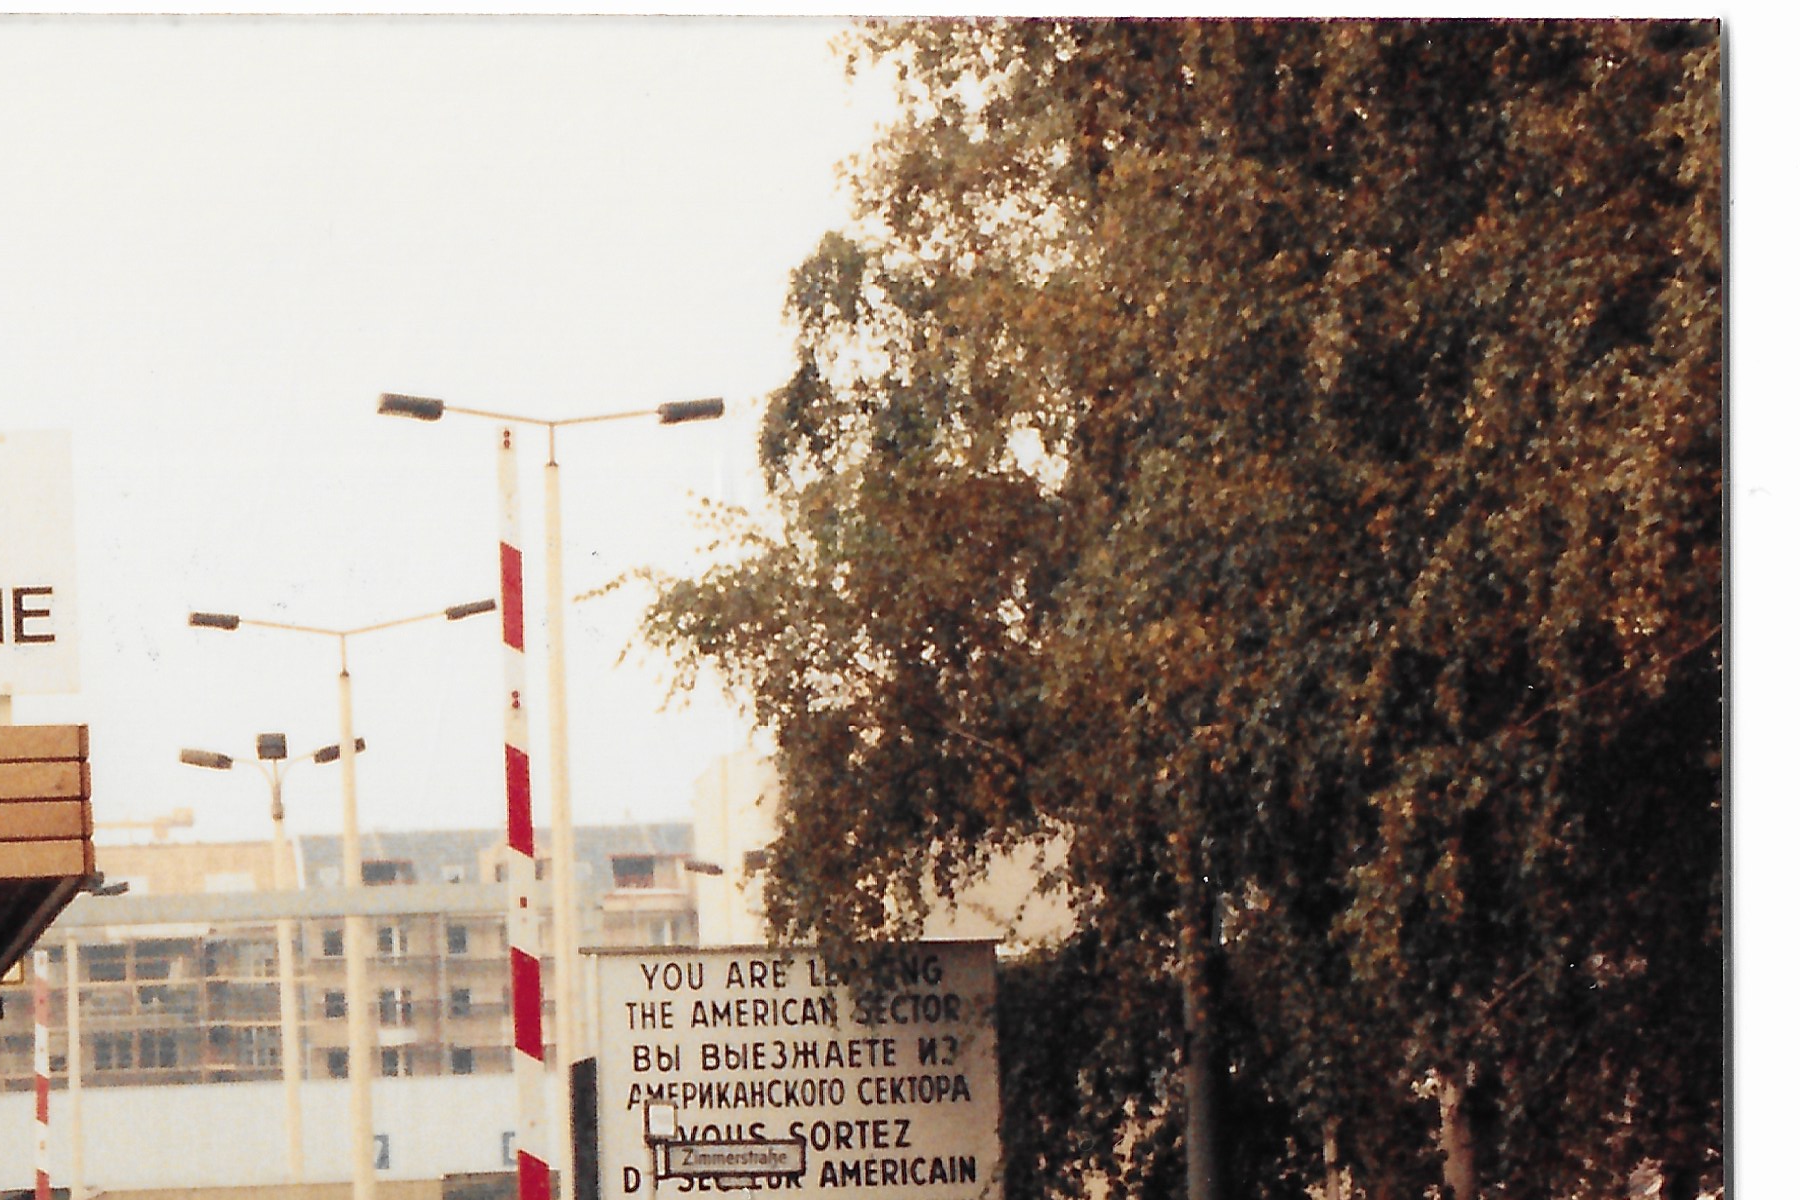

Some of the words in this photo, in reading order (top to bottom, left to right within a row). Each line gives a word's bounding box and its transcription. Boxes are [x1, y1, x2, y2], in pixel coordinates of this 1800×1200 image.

[640, 961, 704, 992] YOU
[725, 959, 788, 990] ARE
[625, 1001, 674, 1030] THE
[690, 996, 838, 1028] AMERICAN
[850, 993, 961, 1026] SECTOR
[701, 1037, 897, 1071] ВЫЕЗЖАЕТЕ
[918, 1035, 959, 1067] ИЗ
[856, 1074, 972, 1106] СЕКТОРА
[789, 1118, 912, 1151] SORTEZ
